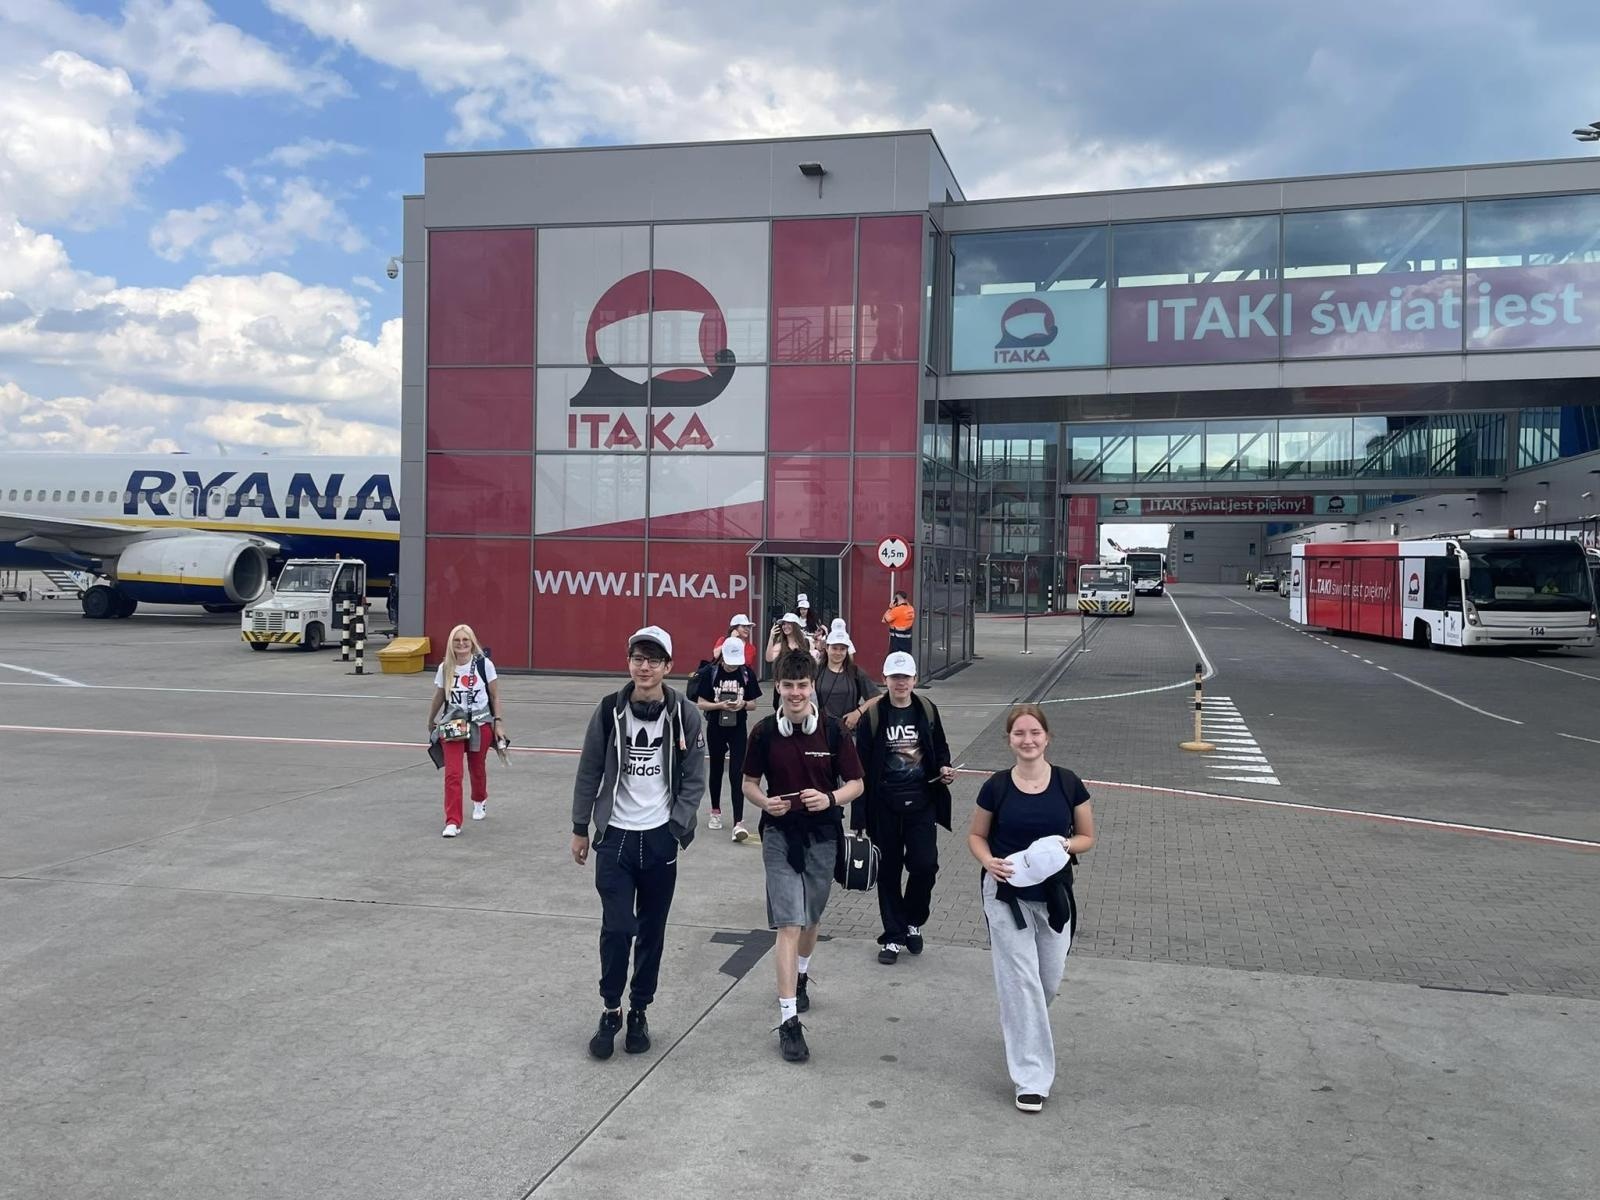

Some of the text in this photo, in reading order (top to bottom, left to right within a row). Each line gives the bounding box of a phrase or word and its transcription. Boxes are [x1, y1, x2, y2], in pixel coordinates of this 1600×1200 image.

[1147, 282, 1583, 342] ITAKI świat jest
[994, 348, 1050, 364] ITAKA
[568, 412, 714, 451] ITAKA
[1150, 498, 1306, 513] ITAKI świat jest piękny!
[534, 570, 762, 600] WWW.ITAKA.PL
[1529, 626, 1545, 637] 114
[452, 675, 460, 688] I
